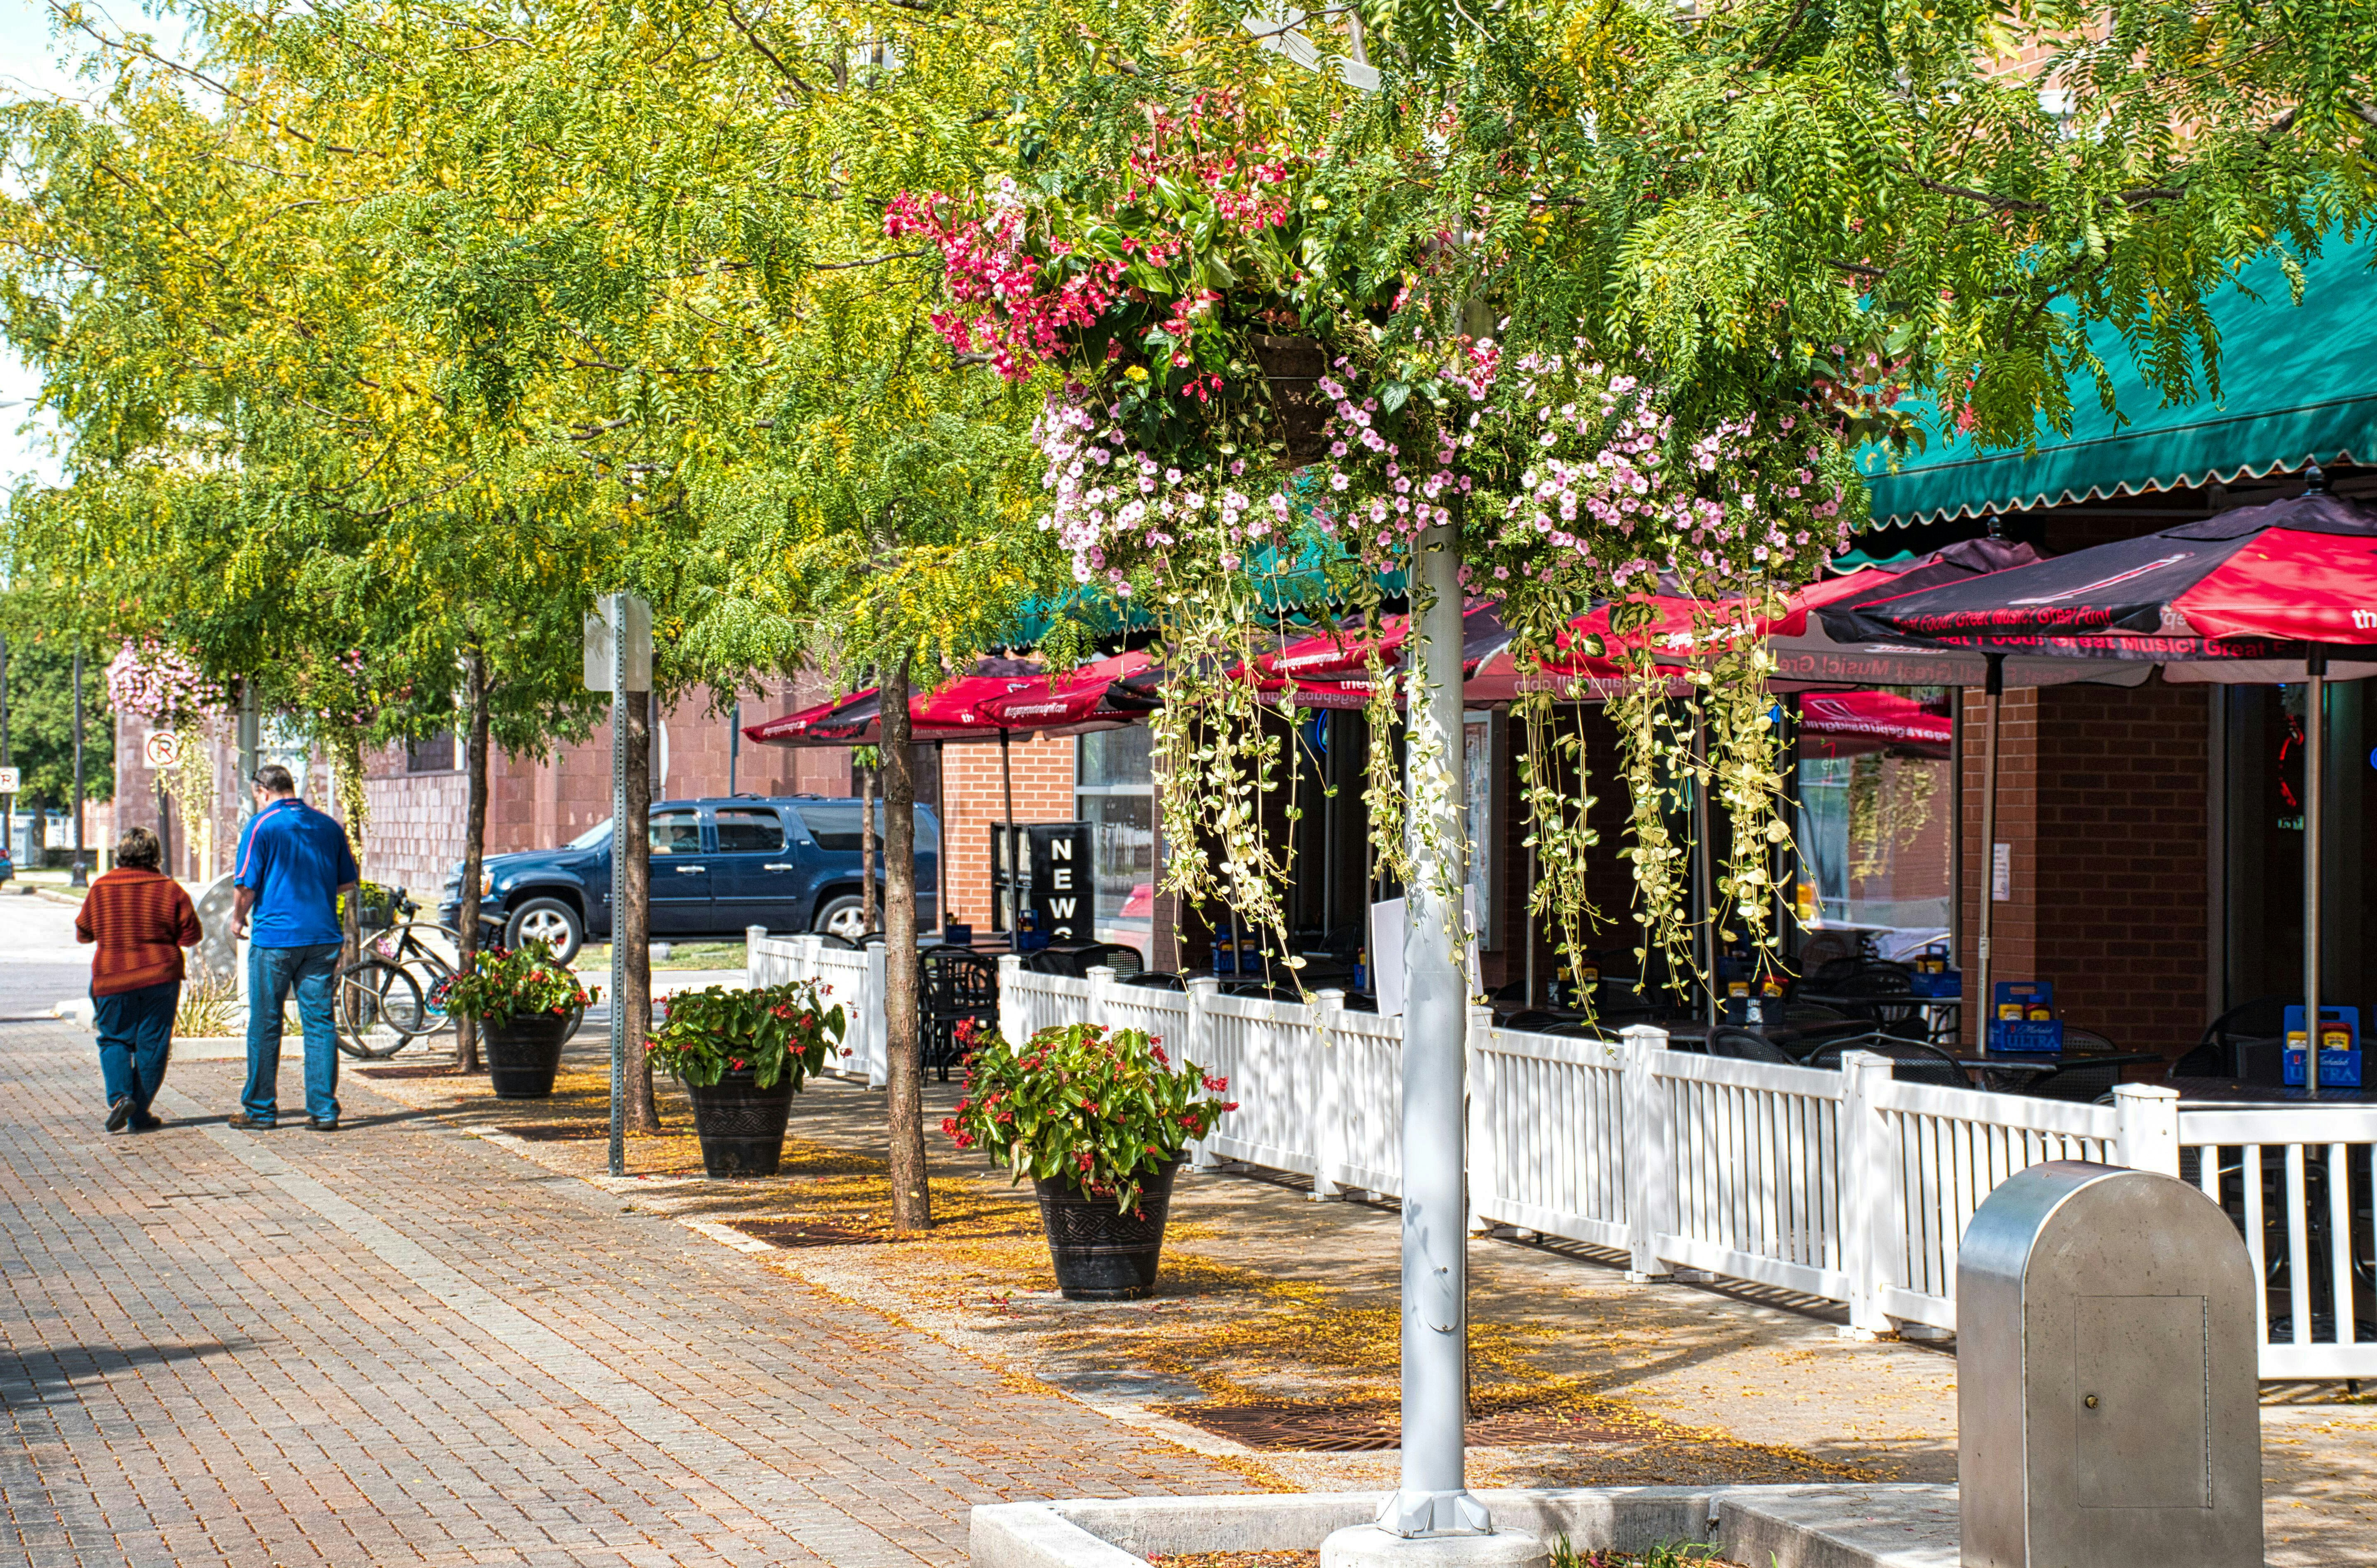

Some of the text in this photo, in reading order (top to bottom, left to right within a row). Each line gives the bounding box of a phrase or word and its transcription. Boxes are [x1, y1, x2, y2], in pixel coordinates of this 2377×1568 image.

[1920, 612, 1957, 632] Food!
[1955, 610, 1992, 627] Great
[1992, 607, 2038, 625] Music!
[2037, 606, 2077, 624] Great
[2075, 605, 2113, 627] Fun!
[2203, 638, 2265, 657] Great
[2007, 1034, 2059, 1048] ULTRA
[2289, 1066, 2353, 1081] UTRA
